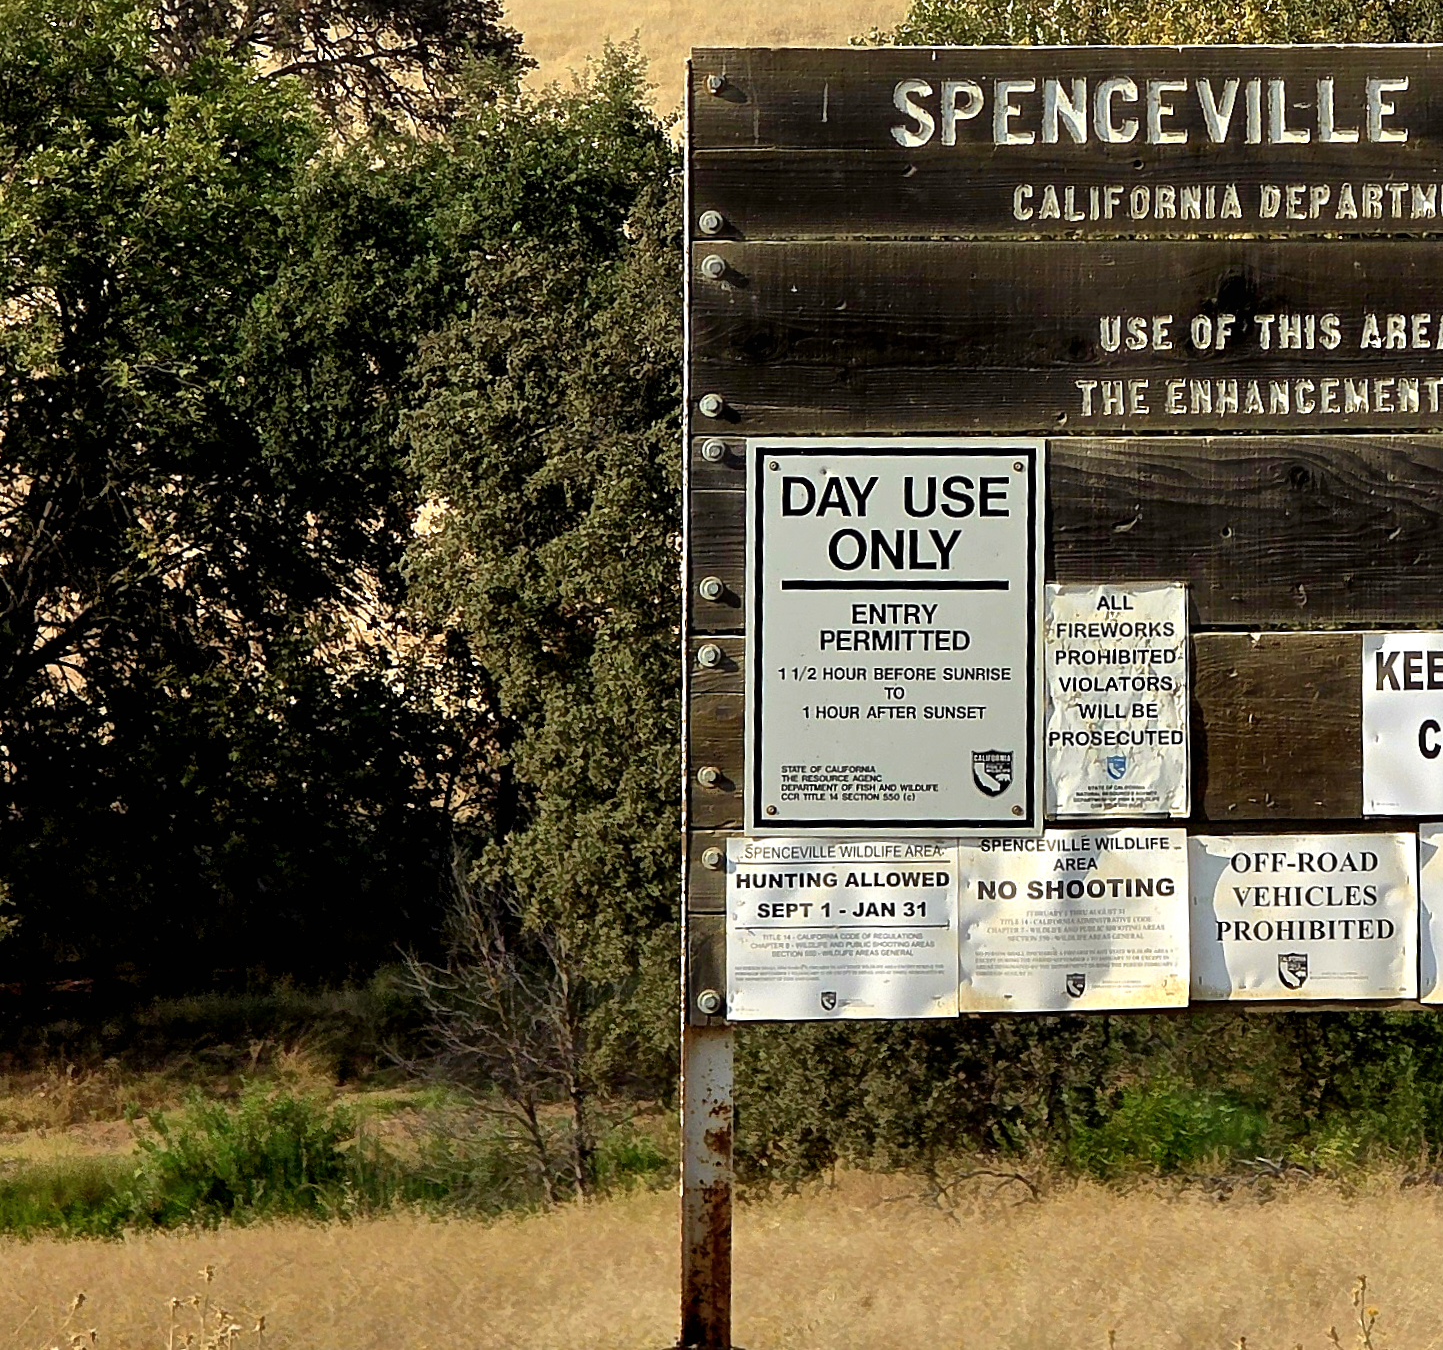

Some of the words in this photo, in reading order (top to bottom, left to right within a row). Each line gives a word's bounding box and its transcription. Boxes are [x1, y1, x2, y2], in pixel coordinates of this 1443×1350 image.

[891, 76, 1410, 148] SPENCEVILLE
[1012, 183, 1243, 222] CALIFORNIA
[1099, 314, 1173, 352] USE
[1191, 314, 1235, 351] OF
[1253, 313, 1341, 351] THIS
[1075, 378, 1150, 416] THE
[1165, 377, 1443, 415] ENHANCEMENT
[781, 475, 879, 518] DAY
[904, 475, 1010, 518] USE
[827, 527, 962, 571] ONLY
[1096, 595, 1134, 611] ALL
[851, 603, 939, 625] ENTRY
[1056, 622, 1175, 638] FIREWORKS
[819, 629, 971, 652] PERMITTED
[1055, 649, 1177, 666] PROHIBITED
[778, 667, 788, 681] 1
[792, 666, 818, 681] 1/2
[822, 667, 868, 681] HOUR
[873, 667, 937, 681] BEFORE
[942, 667, 1012, 681] SUNRISE
[883, 686, 906, 700] TO
[1058, 676, 1174, 693] VIOLATORS
[802, 706, 811, 720] 1
[815, 706, 860, 720] HOUR
[866, 706, 917, 720] AFTER
[923, 706, 987, 720] SUNSET
[1078, 703, 1127, 720] WILL
[1131, 703, 1159, 719] BE
[1049, 730, 1184, 747] PROSECUTED
[781, 765, 807, 773] STATE
[810, 765, 823, 773] OF
[825, 765, 876, 773] CALIFORNIA
[781, 774, 798, 782] THE
[801, 774, 849, 782] RESOURCE
[781, 783, 838, 792] DEPARTMENT
[841, 783, 853, 792] OF
[855, 783, 876, 792] FISH
[878, 783, 897, 792] AND
[900, 783, 939, 792] WILDLIFE
[841, 792, 880, 801] SECTION
[744, 844, 836, 860] SPENCEVILLE
[838, 844, 902, 859] WILDLIFE
[904, 844, 942, 858] AREA
[980, 836, 1091, 852] SPENCEVILLE
[1094, 836, 1170, 851] WILDLIFE
[1053, 857, 1098, 871] AREA
[1230, 851, 1379, 874] OFF-ROAD
[736, 872, 839, 889] HUNTING
[844, 871, 950, 888] ALLOWED
[977, 880, 1018, 900] NO
[1026, 878, 1176, 900] SHOOTING
[1232, 885, 1378, 907] VEHICLES
[757, 902, 814, 919] SEPT
[820, 902, 832, 918] 1
[852, 901, 896, 918] JAN
[902, 901, 928, 918] 31
[1216, 919, 1395, 941] PROHIBITED
